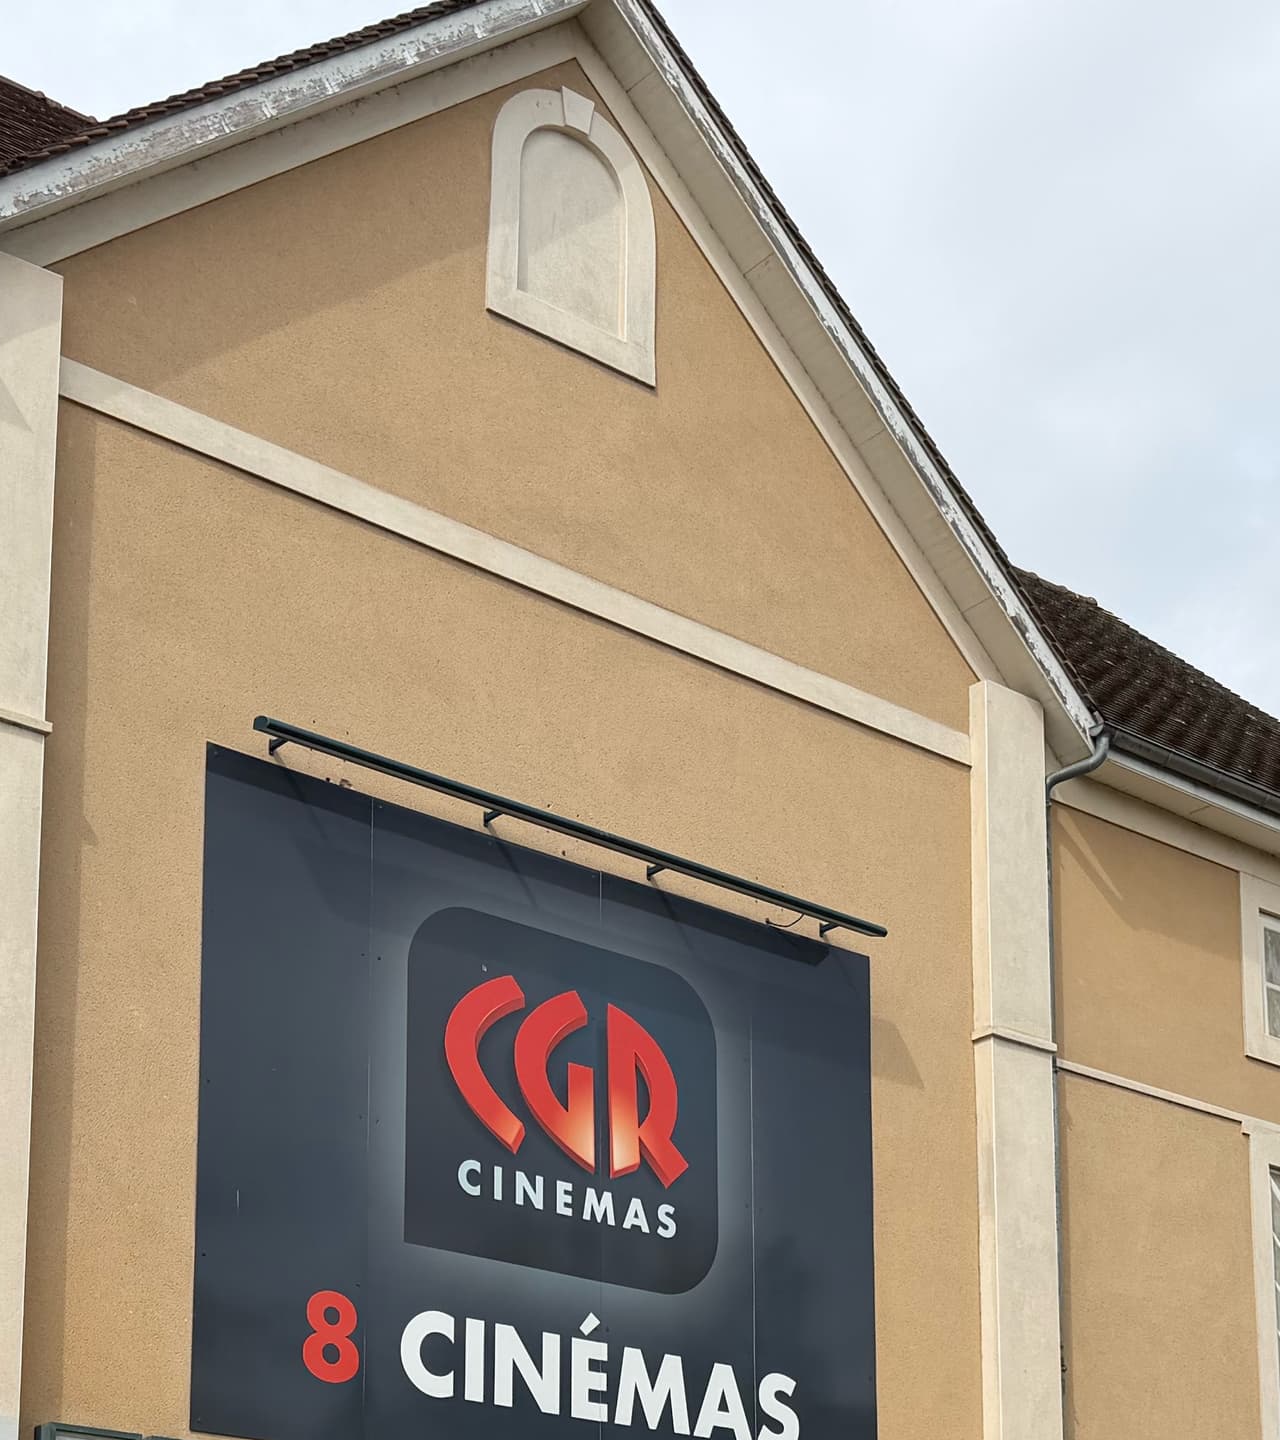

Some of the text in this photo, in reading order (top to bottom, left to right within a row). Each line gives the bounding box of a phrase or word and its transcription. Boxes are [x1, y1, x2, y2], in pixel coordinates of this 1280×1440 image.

[444, 975, 689, 1189] CGR
[457, 1159, 677, 1239] CINEMAS
[302, 1290, 360, 1384] 8
